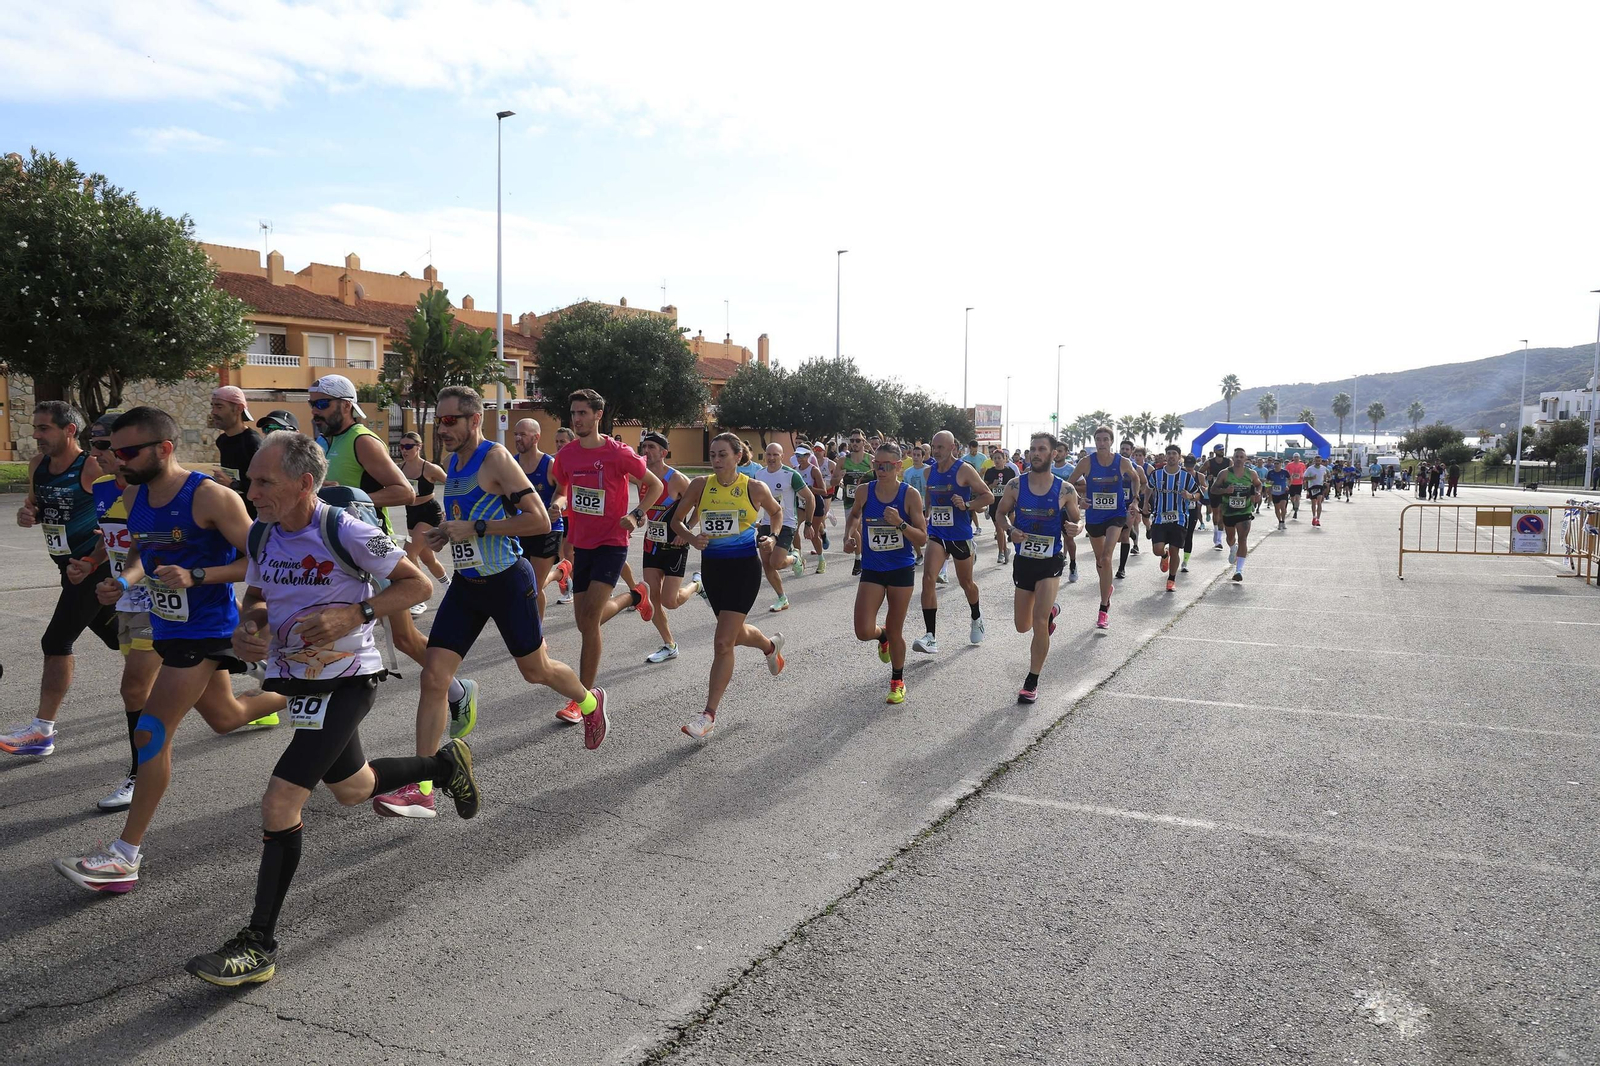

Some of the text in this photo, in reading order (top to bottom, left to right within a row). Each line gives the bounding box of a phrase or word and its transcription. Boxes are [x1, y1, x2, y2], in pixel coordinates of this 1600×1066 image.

[575, 494, 601, 508] 302
[1095, 497, 1115, 505] 308
[933, 512, 951, 521] 313
[705, 520, 734, 531] 387
[45, 534, 62, 547] 81
[872, 534, 900, 545] 475
[1024, 541, 1050, 553] 257
[262, 569, 333, 586] de Valentina
